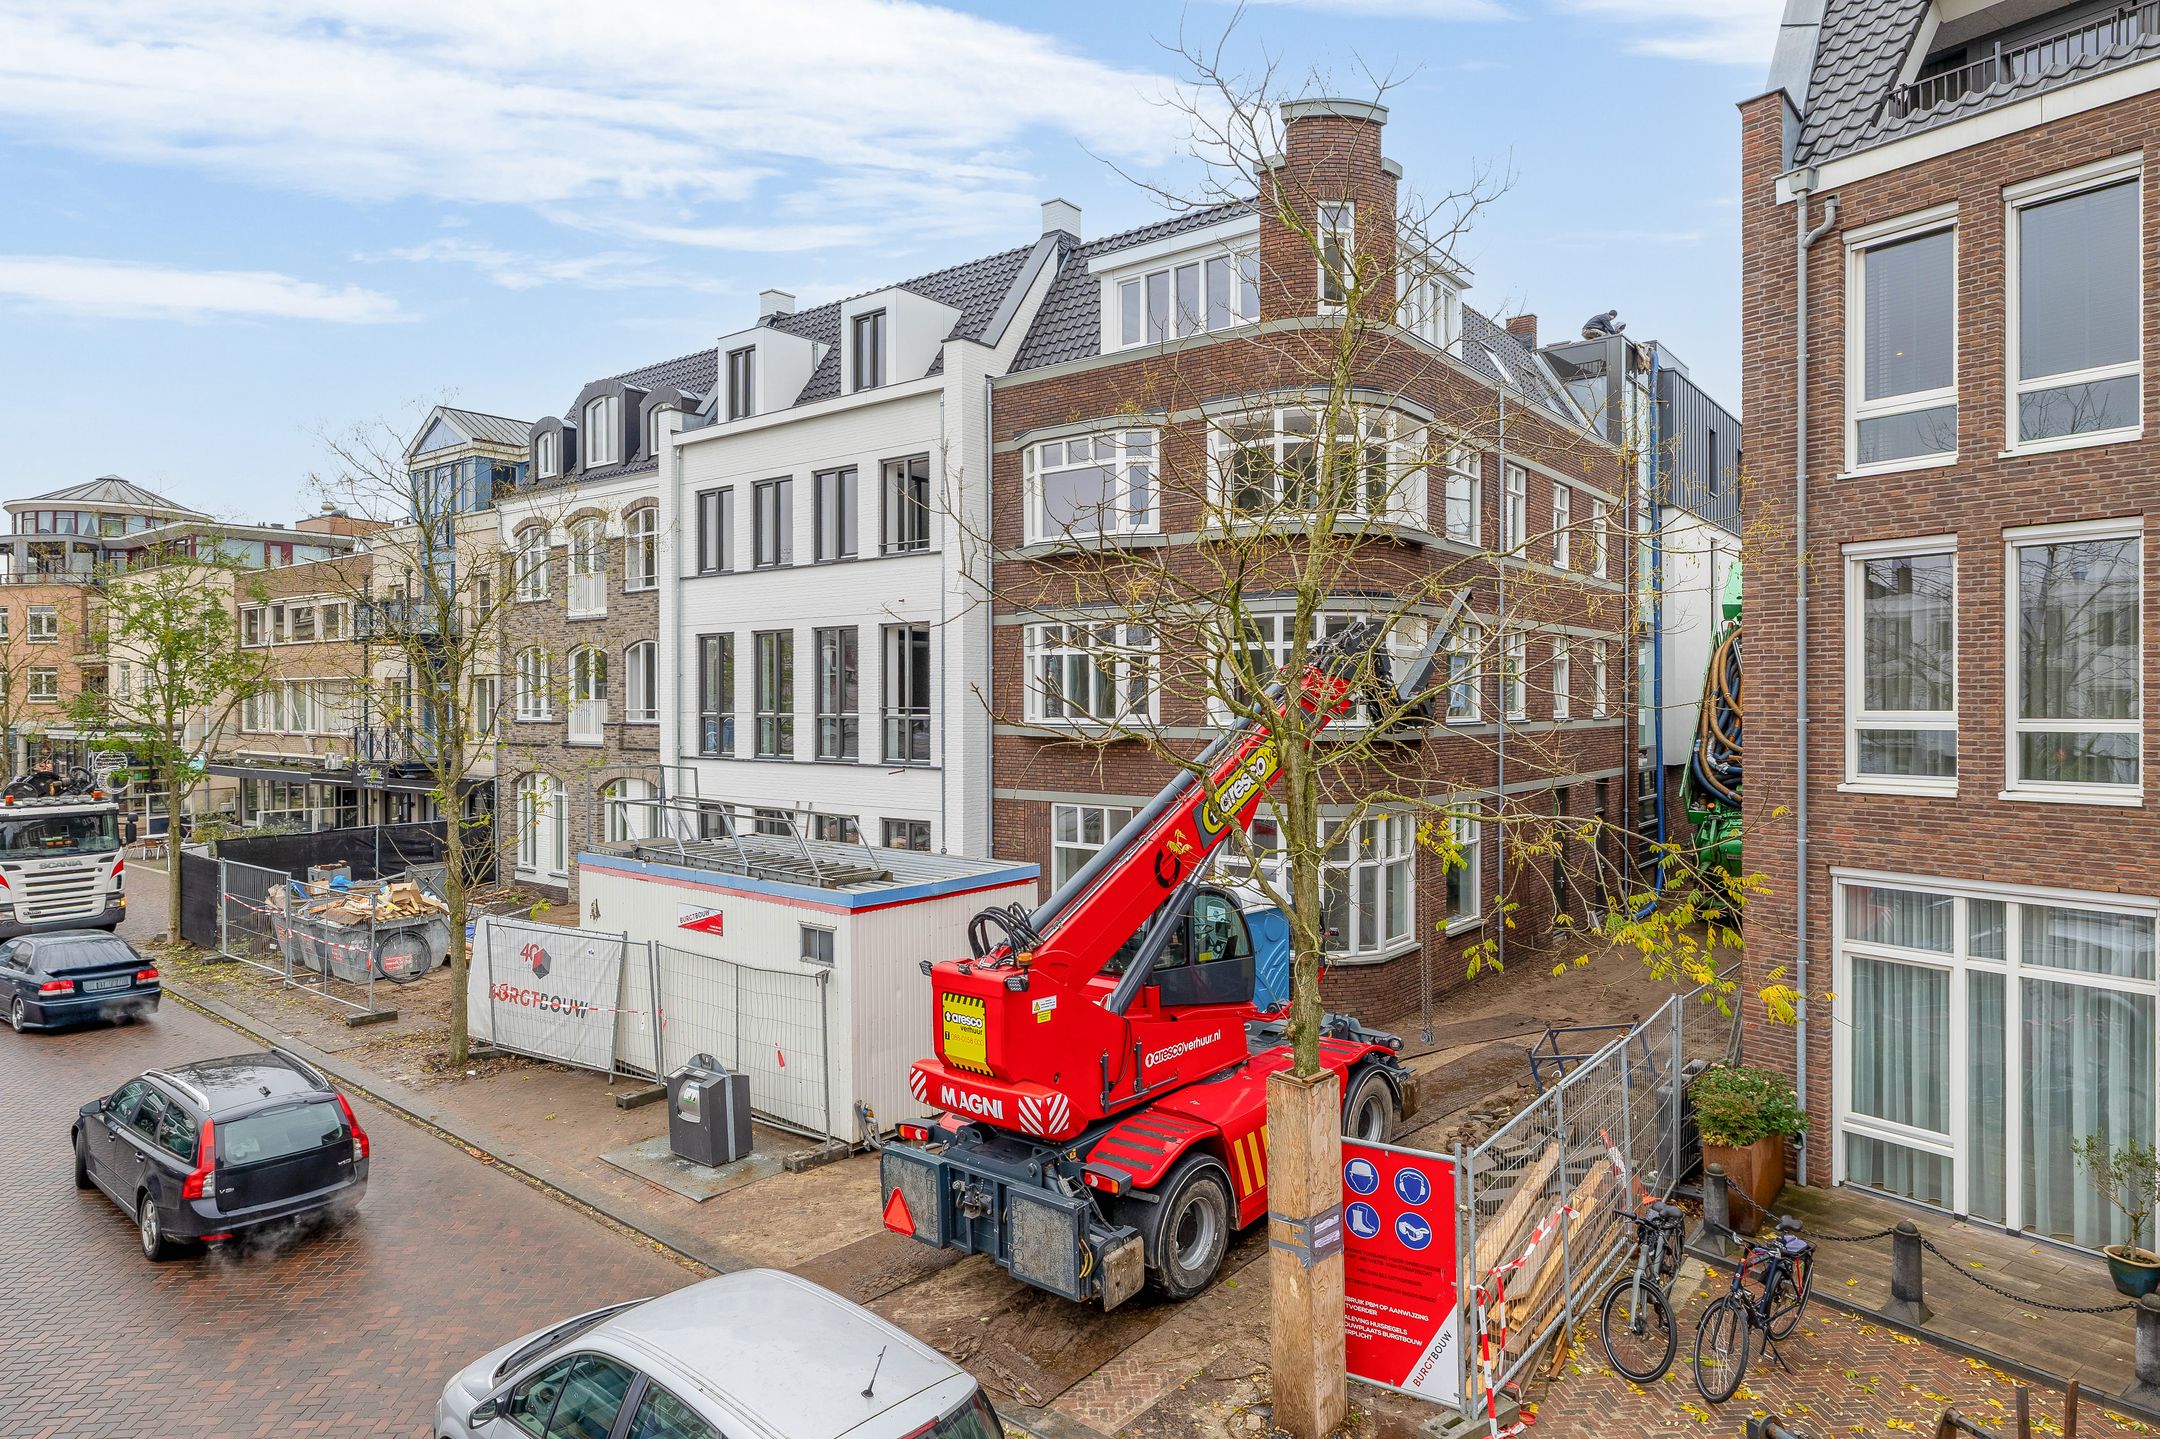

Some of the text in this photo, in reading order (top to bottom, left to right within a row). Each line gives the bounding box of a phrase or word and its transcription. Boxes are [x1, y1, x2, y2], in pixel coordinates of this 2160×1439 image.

[39, 859, 83, 870] SCANIA
[679, 910, 710, 924] BURGTBOUW
[951, 1012, 983, 1028] aresco
[960, 1026, 983, 1036] verhuur
[941, 1085, 1004, 1120] MAGNI
[1344, 1296, 1365, 1305] EBRUIK
[1365, 1300, 1379, 1309] PBM
[1388, 1306, 1429, 1321] AANWIJZING
[1345, 1303, 1377, 1316] TVOERDER
[1344, 1314, 1408, 1335] ALEVING HUISREGELS
[1344, 1321, 1423, 1346] OUWPLAATS BURGTBOUW
[1345, 1329, 1373, 1340] ERPLICHT
[1412, 1330, 1453, 1387] BURGTBOUW
